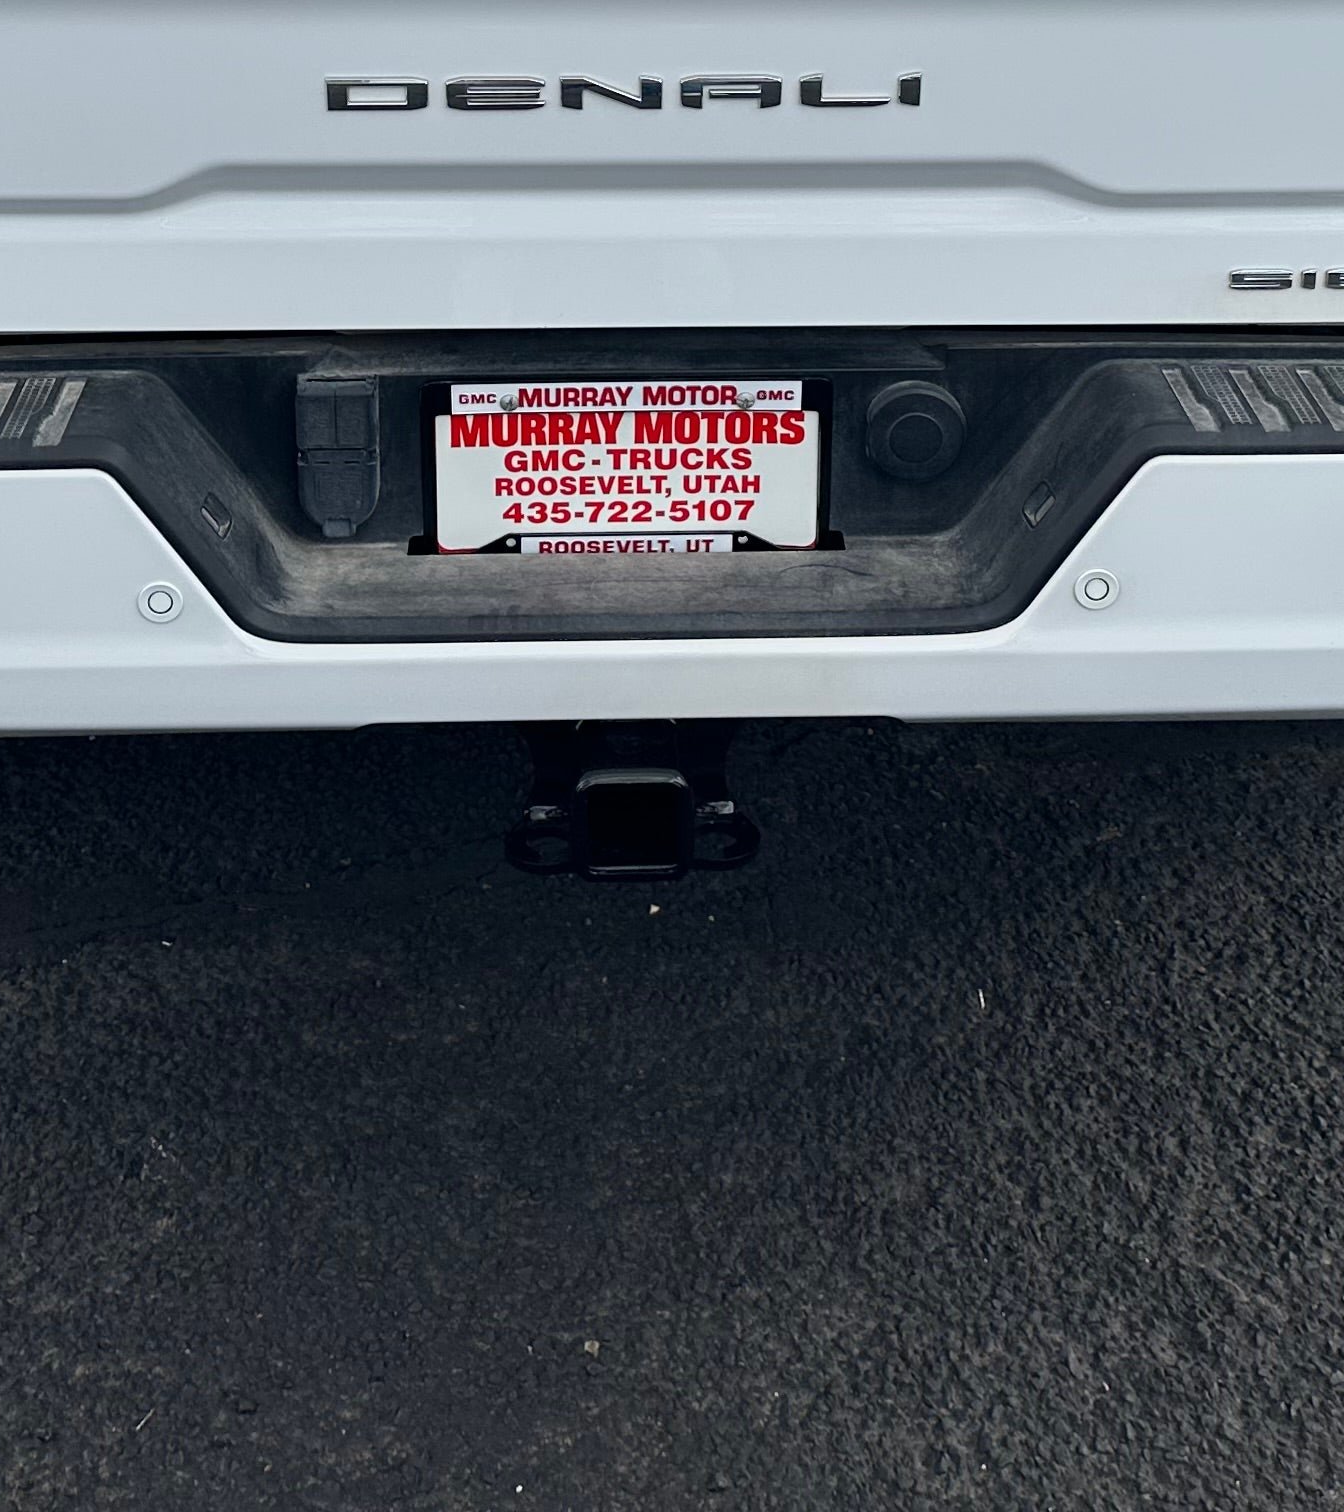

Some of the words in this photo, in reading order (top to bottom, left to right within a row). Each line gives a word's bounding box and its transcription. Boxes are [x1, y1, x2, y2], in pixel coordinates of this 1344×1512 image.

[325, 71, 923, 111] DENALI
[458, 393, 497, 405] GMC
[517, 386, 633, 408] MURRAY
[642, 385, 738, 406] MOTOR
[756, 389, 795, 401] GMC
[450, 412, 624, 448] MURRAY
[633, 410, 805, 445] MOTORS
[495, 475, 672, 498] ROOSEVELT,
[683, 474, 760, 494] UTAH
[502, 499, 755, 524] 435-722-5107
[686, 539, 714, 553] UT
